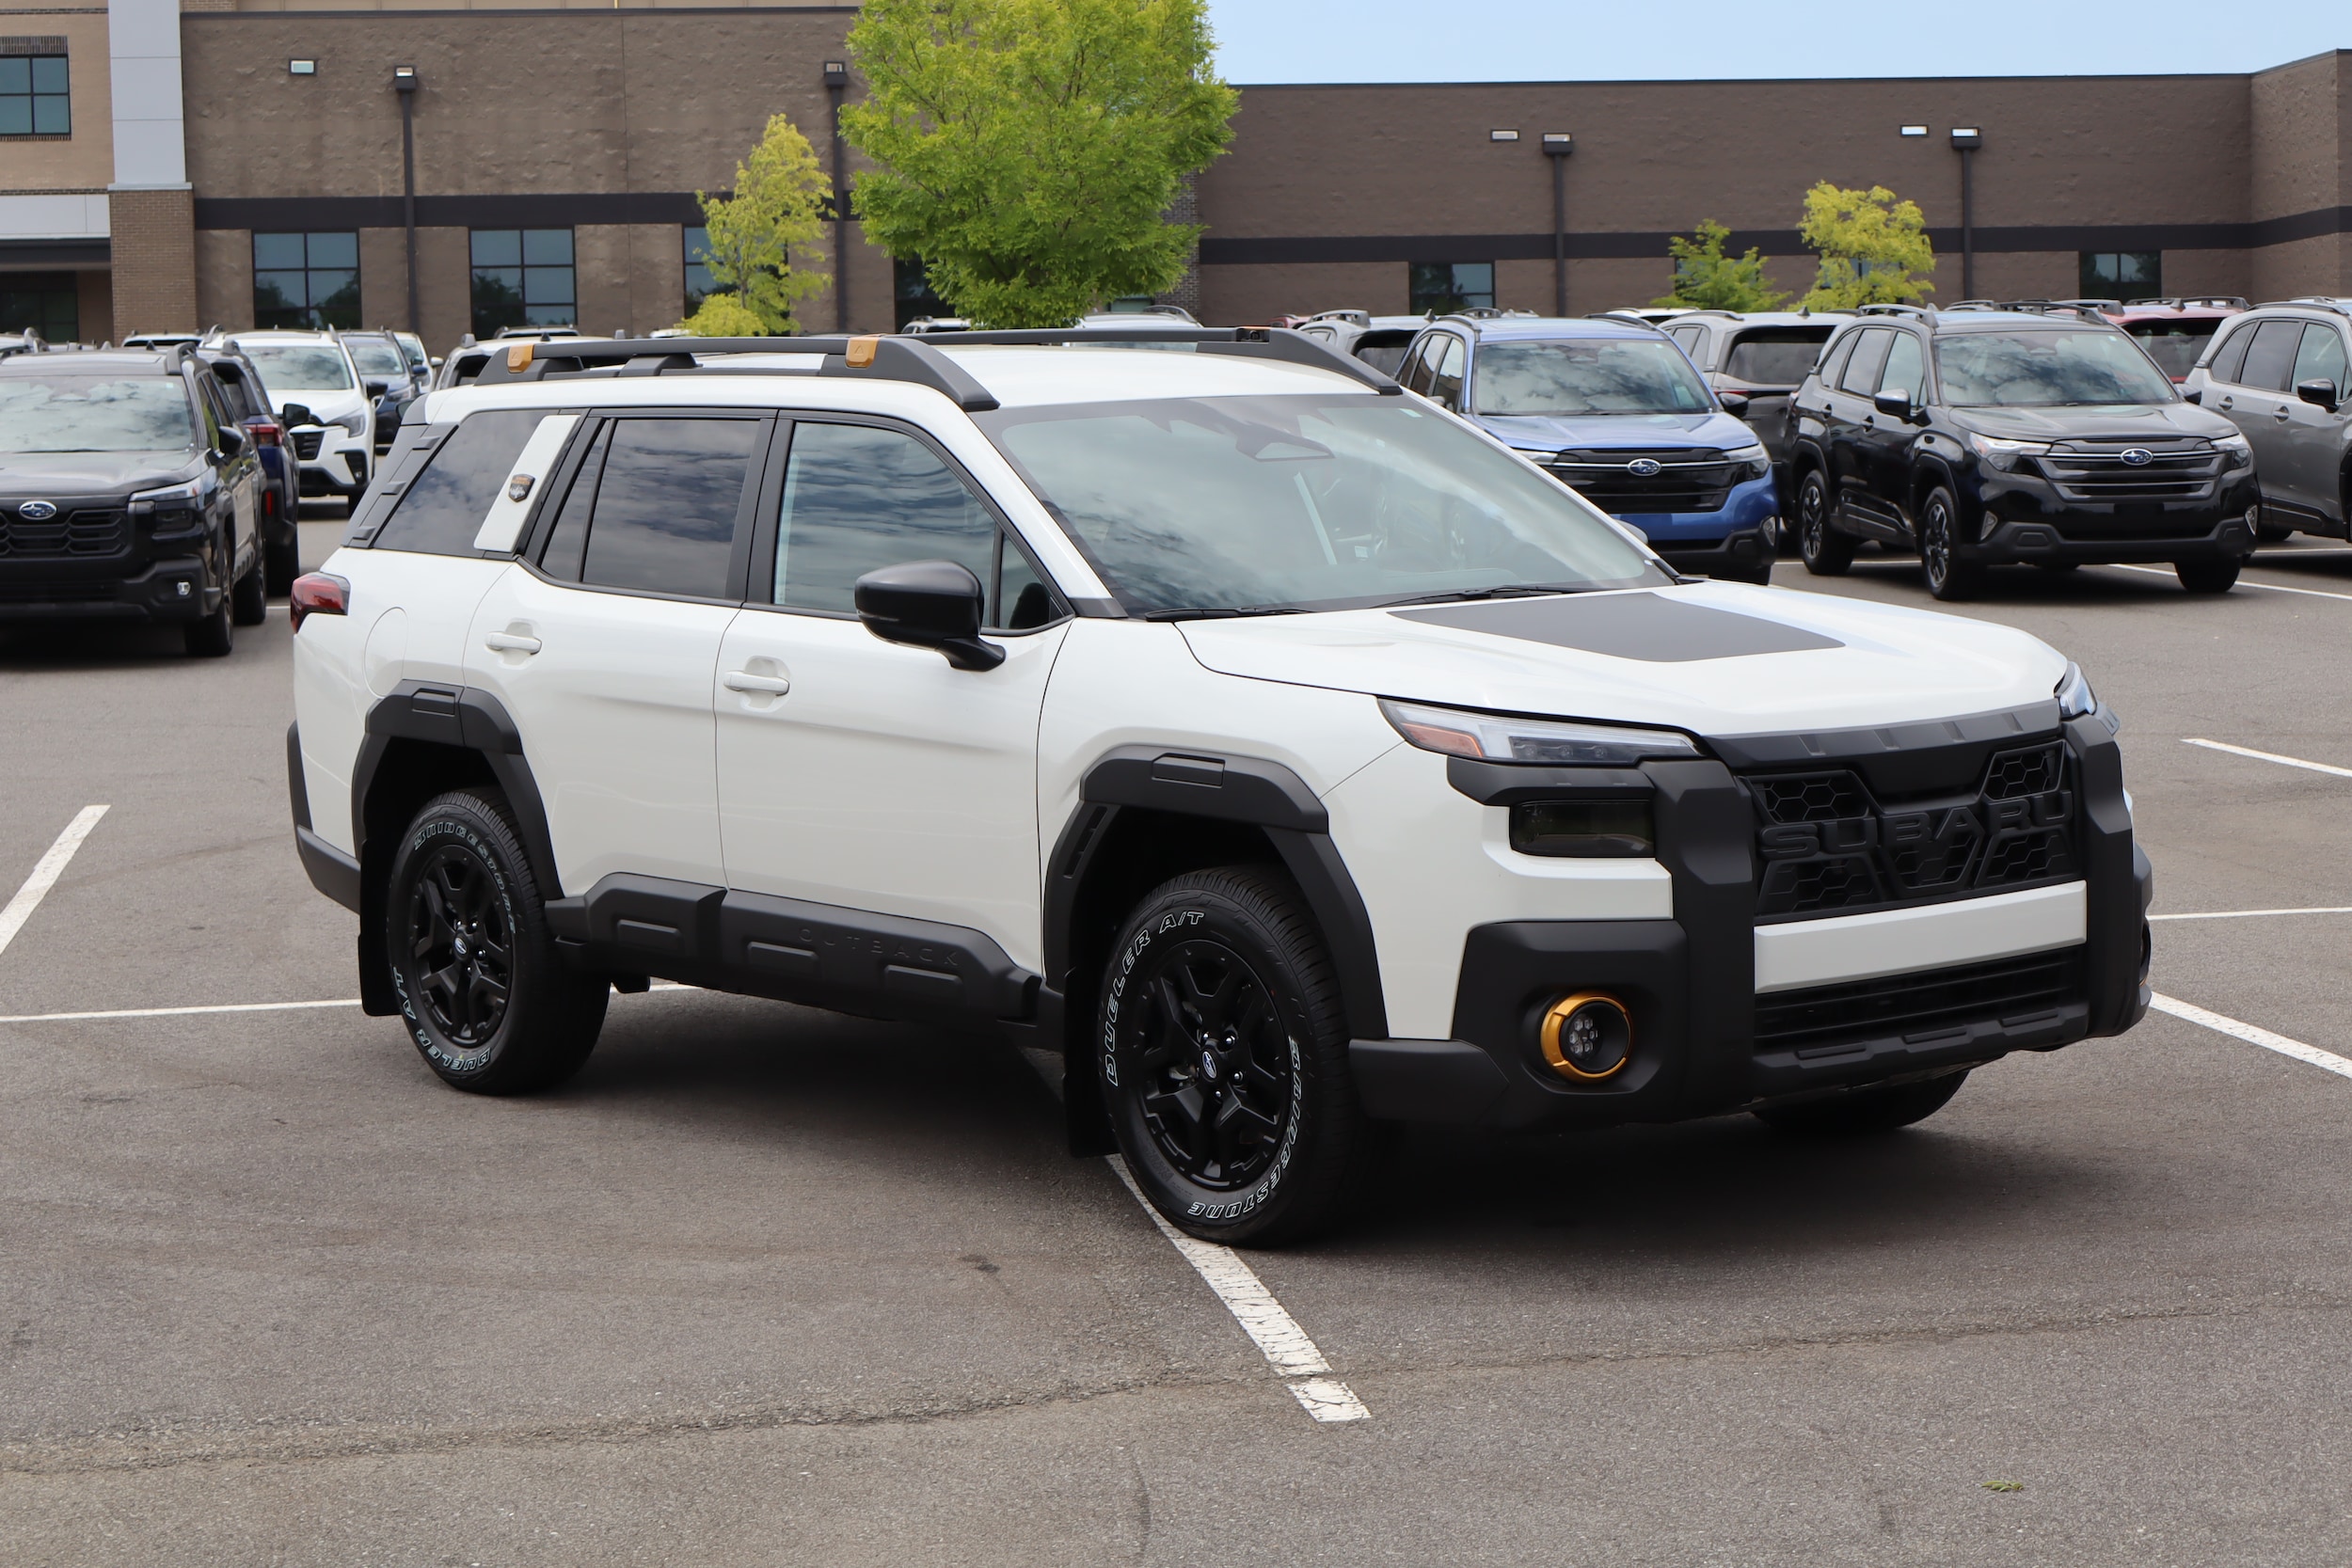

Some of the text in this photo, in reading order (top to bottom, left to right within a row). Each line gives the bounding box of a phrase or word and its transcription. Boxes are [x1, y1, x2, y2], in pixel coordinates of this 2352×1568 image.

[414, 822, 516, 934] BRIDGESTONE
[1759, 790, 2073, 860] SUBARU
[798, 927, 959, 967] OUTBACK
[1104, 911, 1205, 1087] DUELER A/T
[392, 965, 492, 1071] DUELER A/T
[1187, 1035, 1302, 1220] BRIDGESTONE
